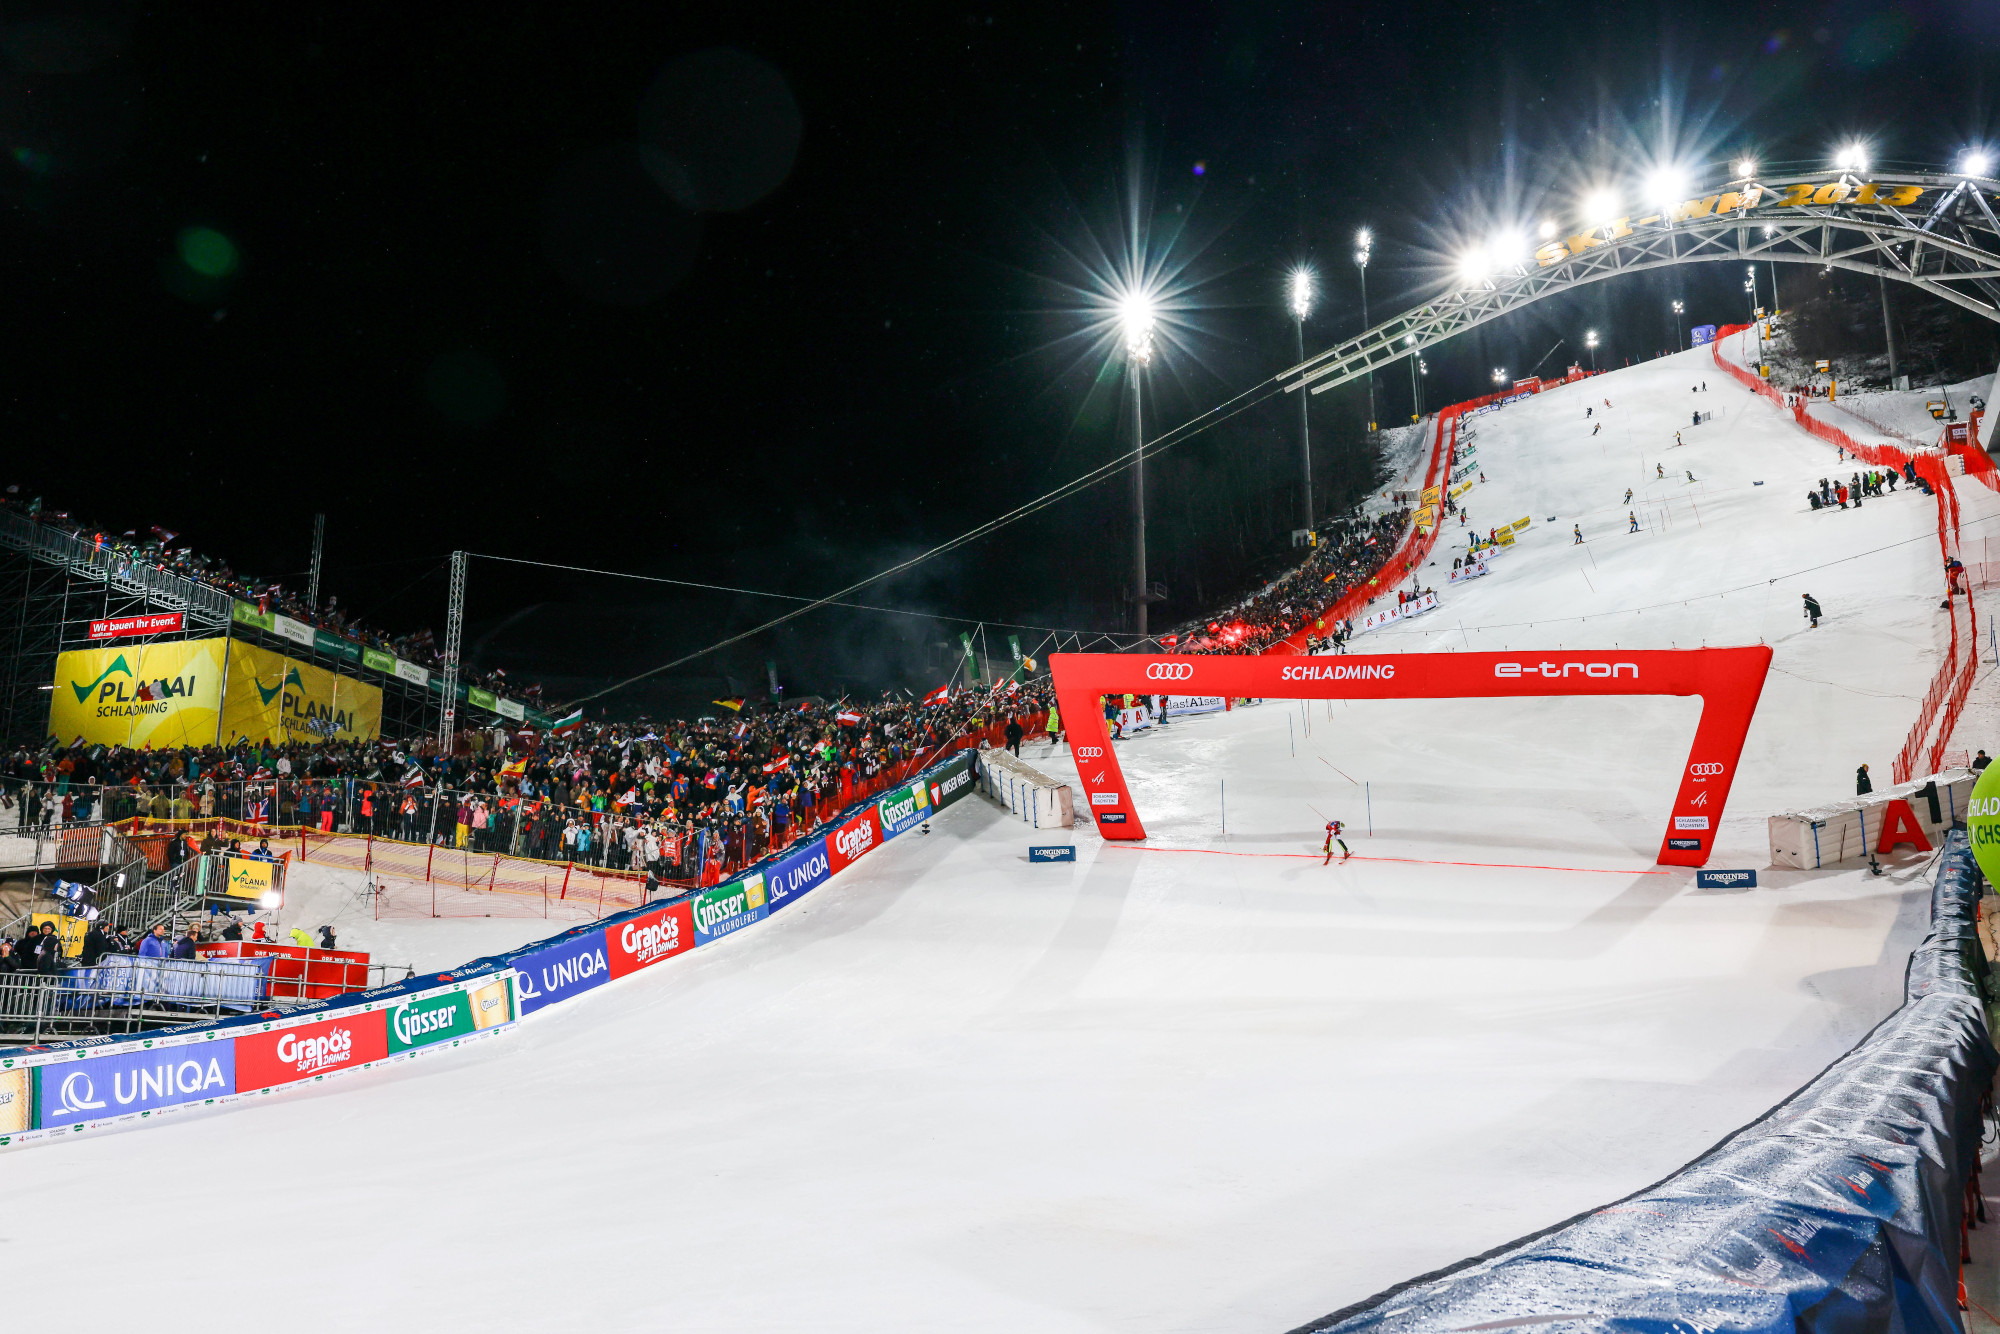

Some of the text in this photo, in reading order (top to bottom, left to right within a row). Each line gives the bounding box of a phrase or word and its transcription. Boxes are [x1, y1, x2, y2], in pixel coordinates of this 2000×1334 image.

[1777, 183, 1924, 207] 2013
[93, 623, 108, 632] Wir
[109, 621, 134, 631] bauen
[136, 619, 149, 628] Ihr
[150, 617, 176, 627] Event.
[1281, 664, 1395, 680] SCHLADMING
[1494, 661, 1639, 678] e-tron
[98, 675, 196, 703] PLAAI
[96, 701, 168, 717] SCHLADMING
[281, 691, 353, 732] PLANAI
[879, 796, 915, 831] Gösser
[1034, 848, 1070, 856] LONGINES
[240, 877, 268, 886] PLANAI
[788, 853, 829, 890] UNIQA
[693, 893, 745, 935] Gösser
[713, 910, 758, 937] ALKOHOLFREI
[637, 938, 679, 962] SOFT DRINKS
[542, 948, 608, 992] UNIQA
[480, 998, 499, 1012] Gösser
[393, 1003, 457, 1045] Gösser
[48, 1041, 71, 1049] Ski
[73, 1036, 114, 1048] Austria
[296, 1050, 351, 1071] SOFT DRINKS
[114, 1057, 226, 1105] UNIQA
